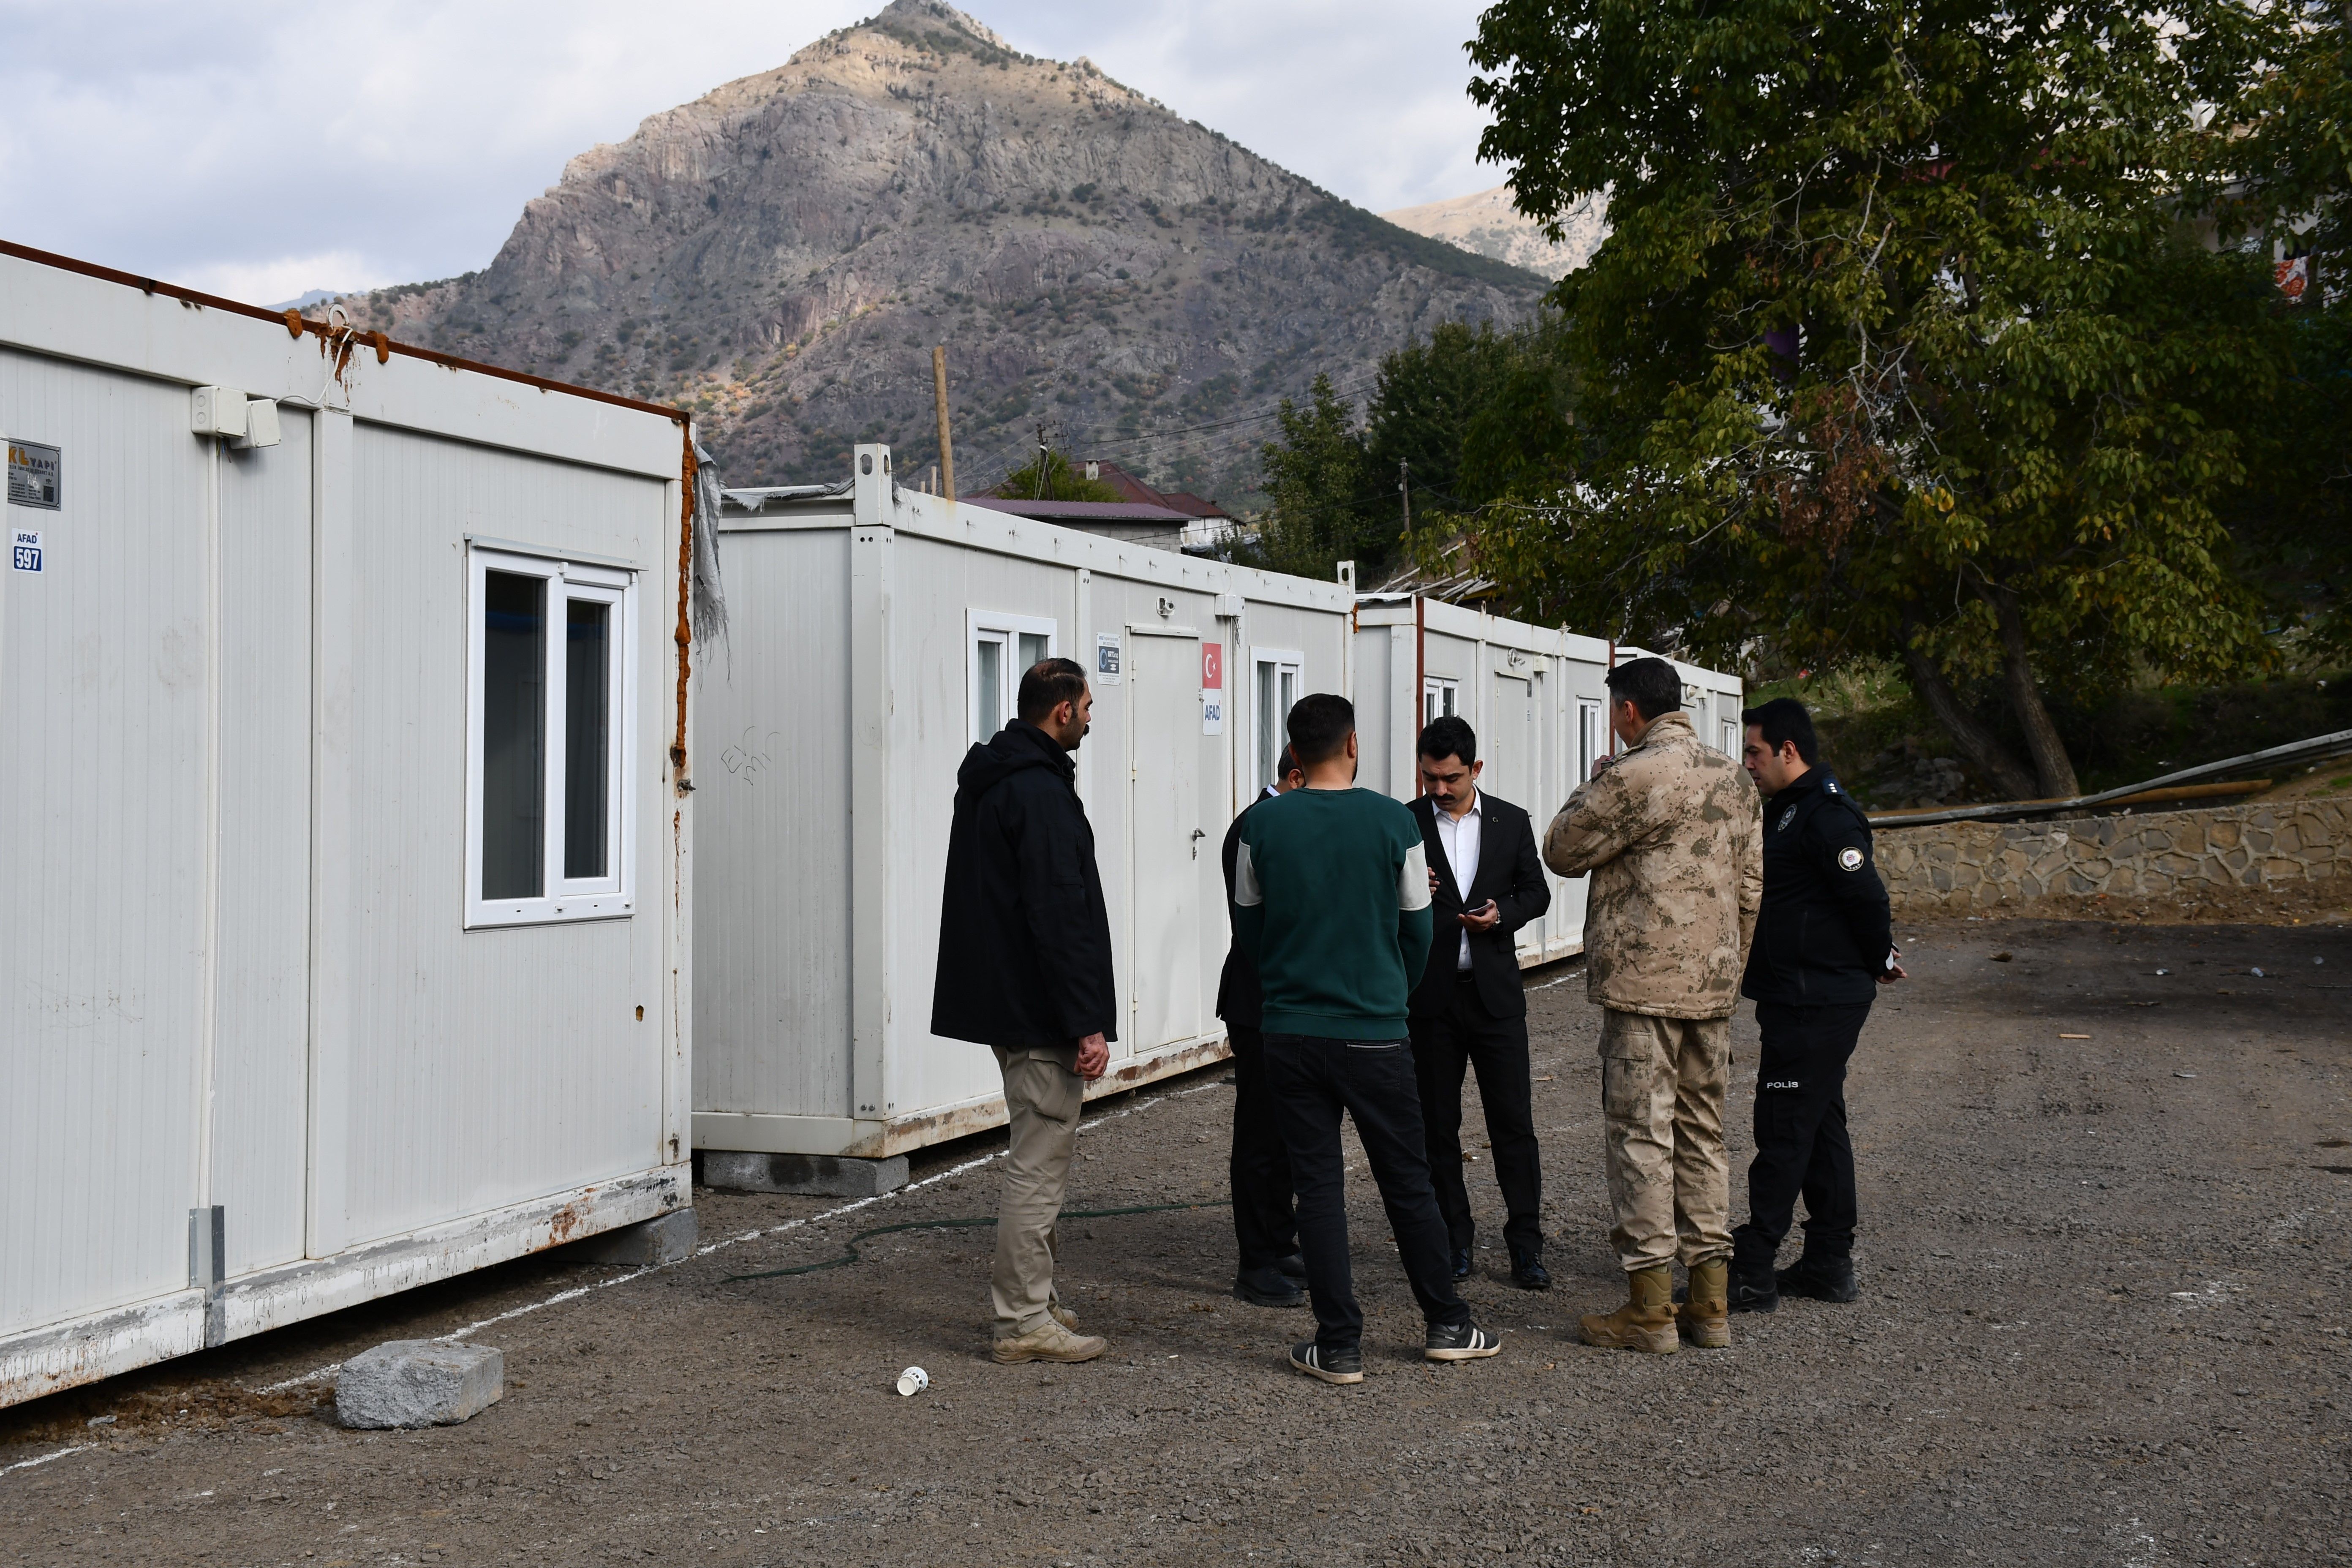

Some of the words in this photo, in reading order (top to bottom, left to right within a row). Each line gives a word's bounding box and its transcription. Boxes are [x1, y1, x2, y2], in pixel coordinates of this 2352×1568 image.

[30, 457, 54, 471] YAPI
[17, 533, 37, 544] AFAD
[16, 548, 39, 569] 597
[1205, 705, 1220, 721] AFAD
